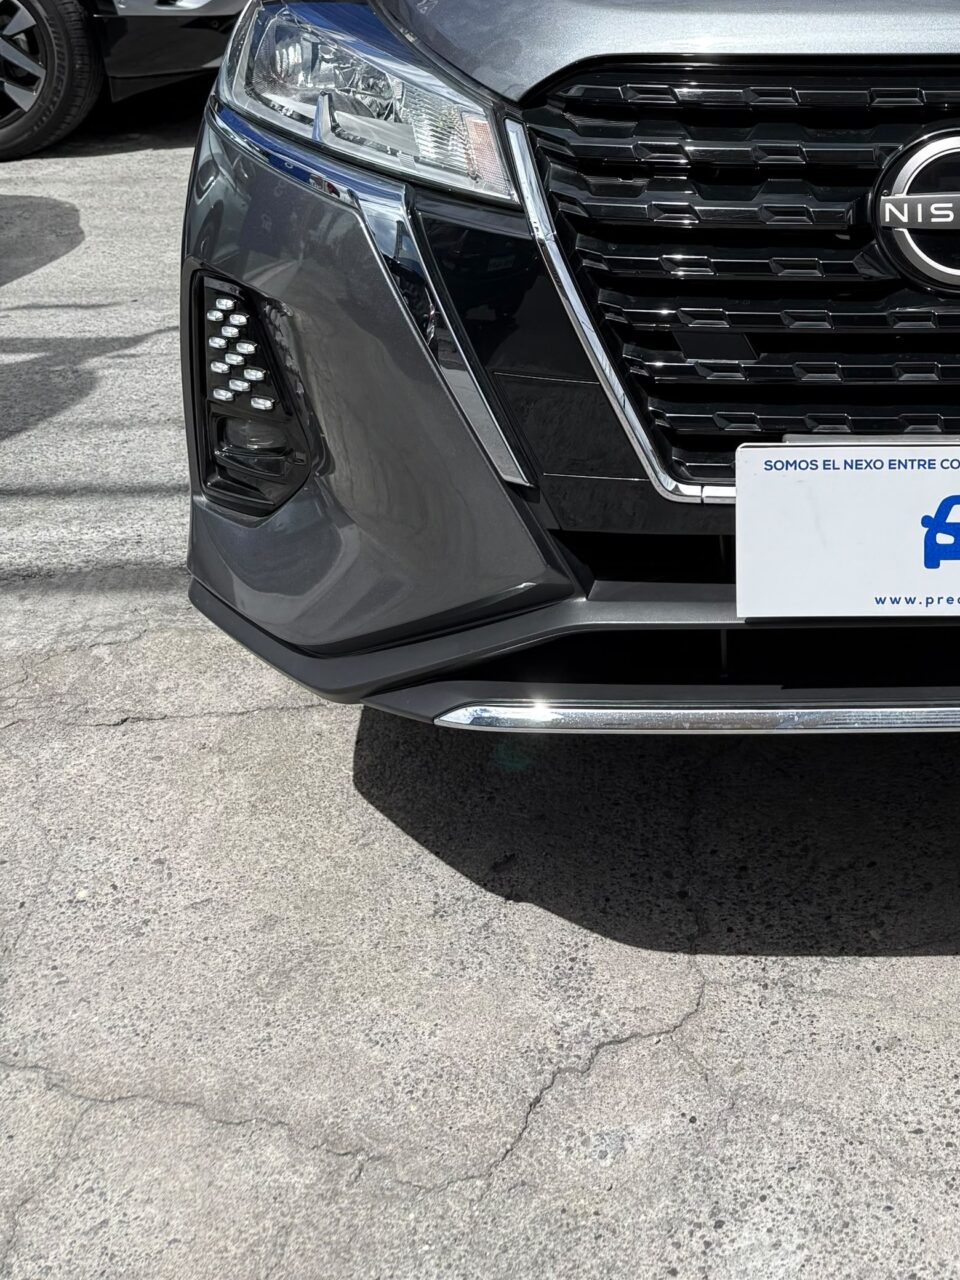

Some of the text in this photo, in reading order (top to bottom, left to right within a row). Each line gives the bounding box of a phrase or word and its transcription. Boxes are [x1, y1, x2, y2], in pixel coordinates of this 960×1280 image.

[763, 459, 819, 471] SOMOS
[822, 459, 840, 471] EL
[843, 459, 884, 470] NEXO
[888, 458, 937, 470] ENTRE
